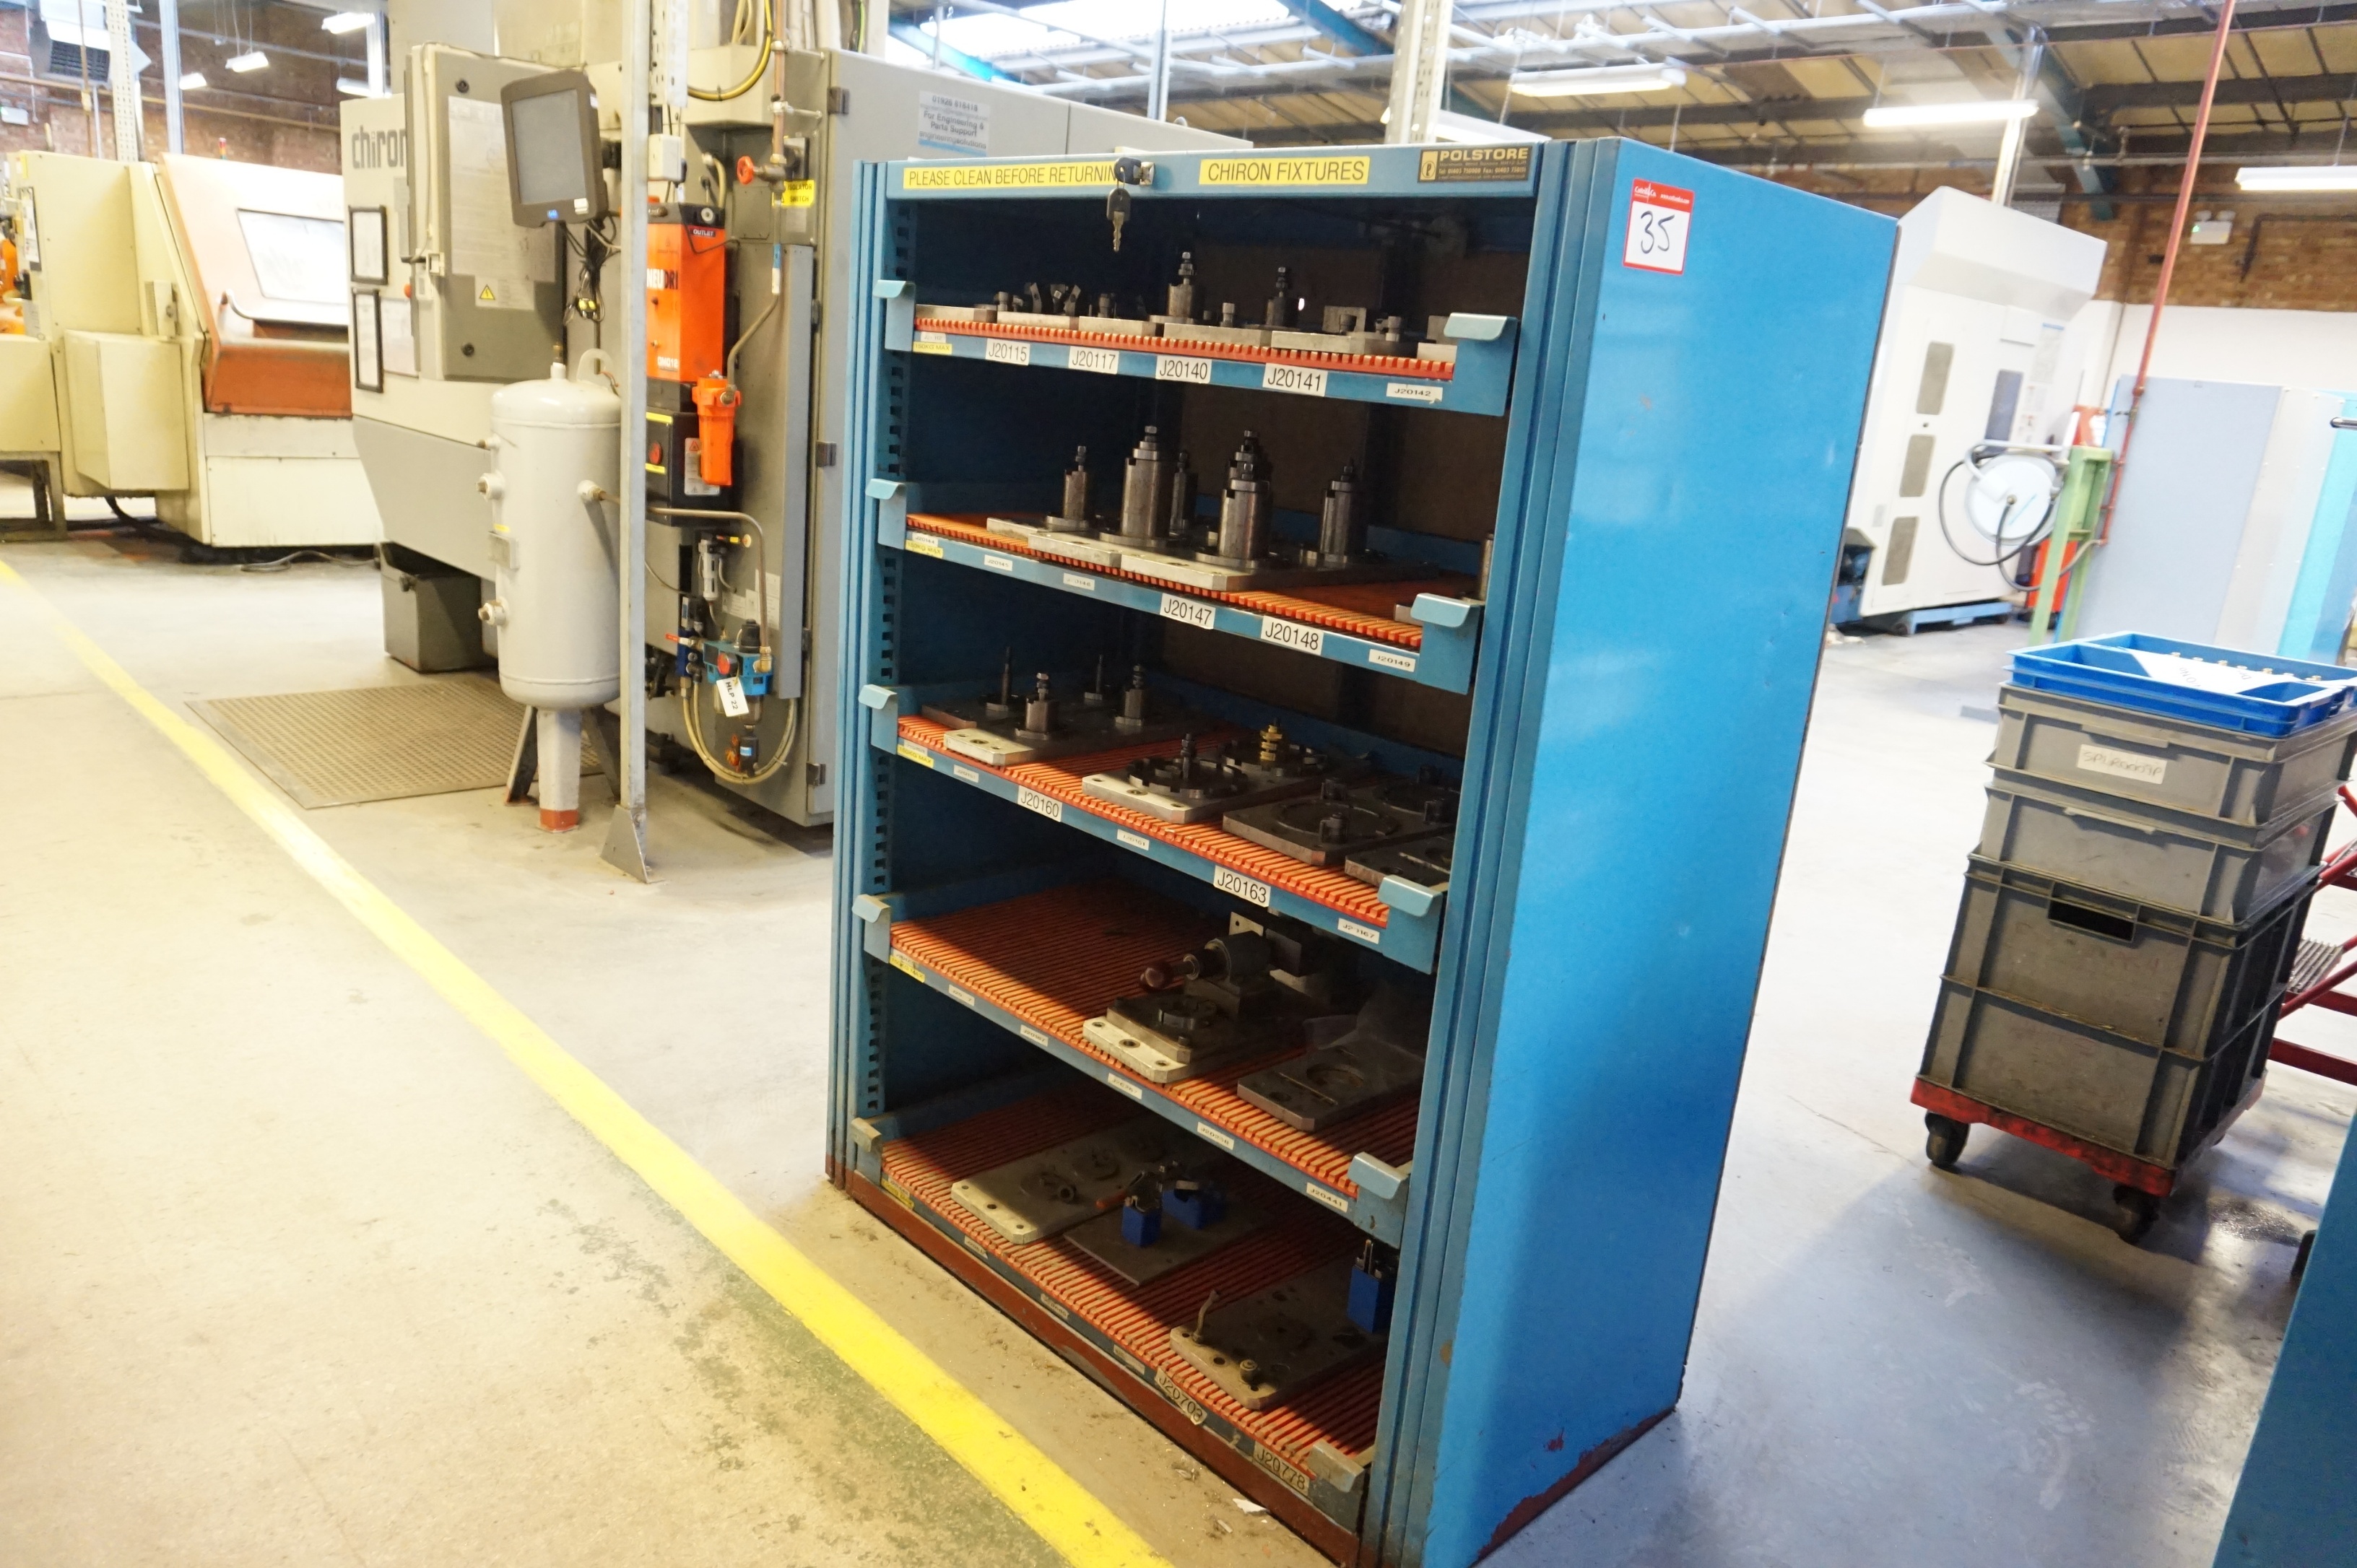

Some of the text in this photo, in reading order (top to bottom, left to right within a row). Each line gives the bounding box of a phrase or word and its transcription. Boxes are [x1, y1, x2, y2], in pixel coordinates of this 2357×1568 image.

[924, 110, 934, 119] For
[937, 113, 978, 129] Engineering
[930, 121, 978, 136] Parts Support
[1439, 147, 1529, 161] POLSTORE
[909, 165, 1116, 186] PLEASE CLEAN BEFORE RETURNIN
[1208, 160, 1365, 181] CHIRON FIXTURES
[1641, 210, 1675, 254] 35
[646, 268, 679, 289] NEUDRI
[989, 342, 1028, 362] J20115
[1072, 349, 1116, 370] J20117
[1159, 360, 1208, 380] J20140
[1267, 367, 1321, 392] J20141
[1394, 388, 1431, 397] J20142
[1164, 598, 1212, 626] J20147
[1265, 622, 1320, 651] J20148
[1377, 655, 1411, 668] J20149
[725, 681, 739, 710] HLP 22
[1020, 790, 1059, 819] J20160
[1217, 871, 1267, 904] J20163
[1310, 1188, 1342, 1208] J20441
[1158, 1374, 1204, 1422] J20703
[1256, 1448, 1306, 1491] J20778
